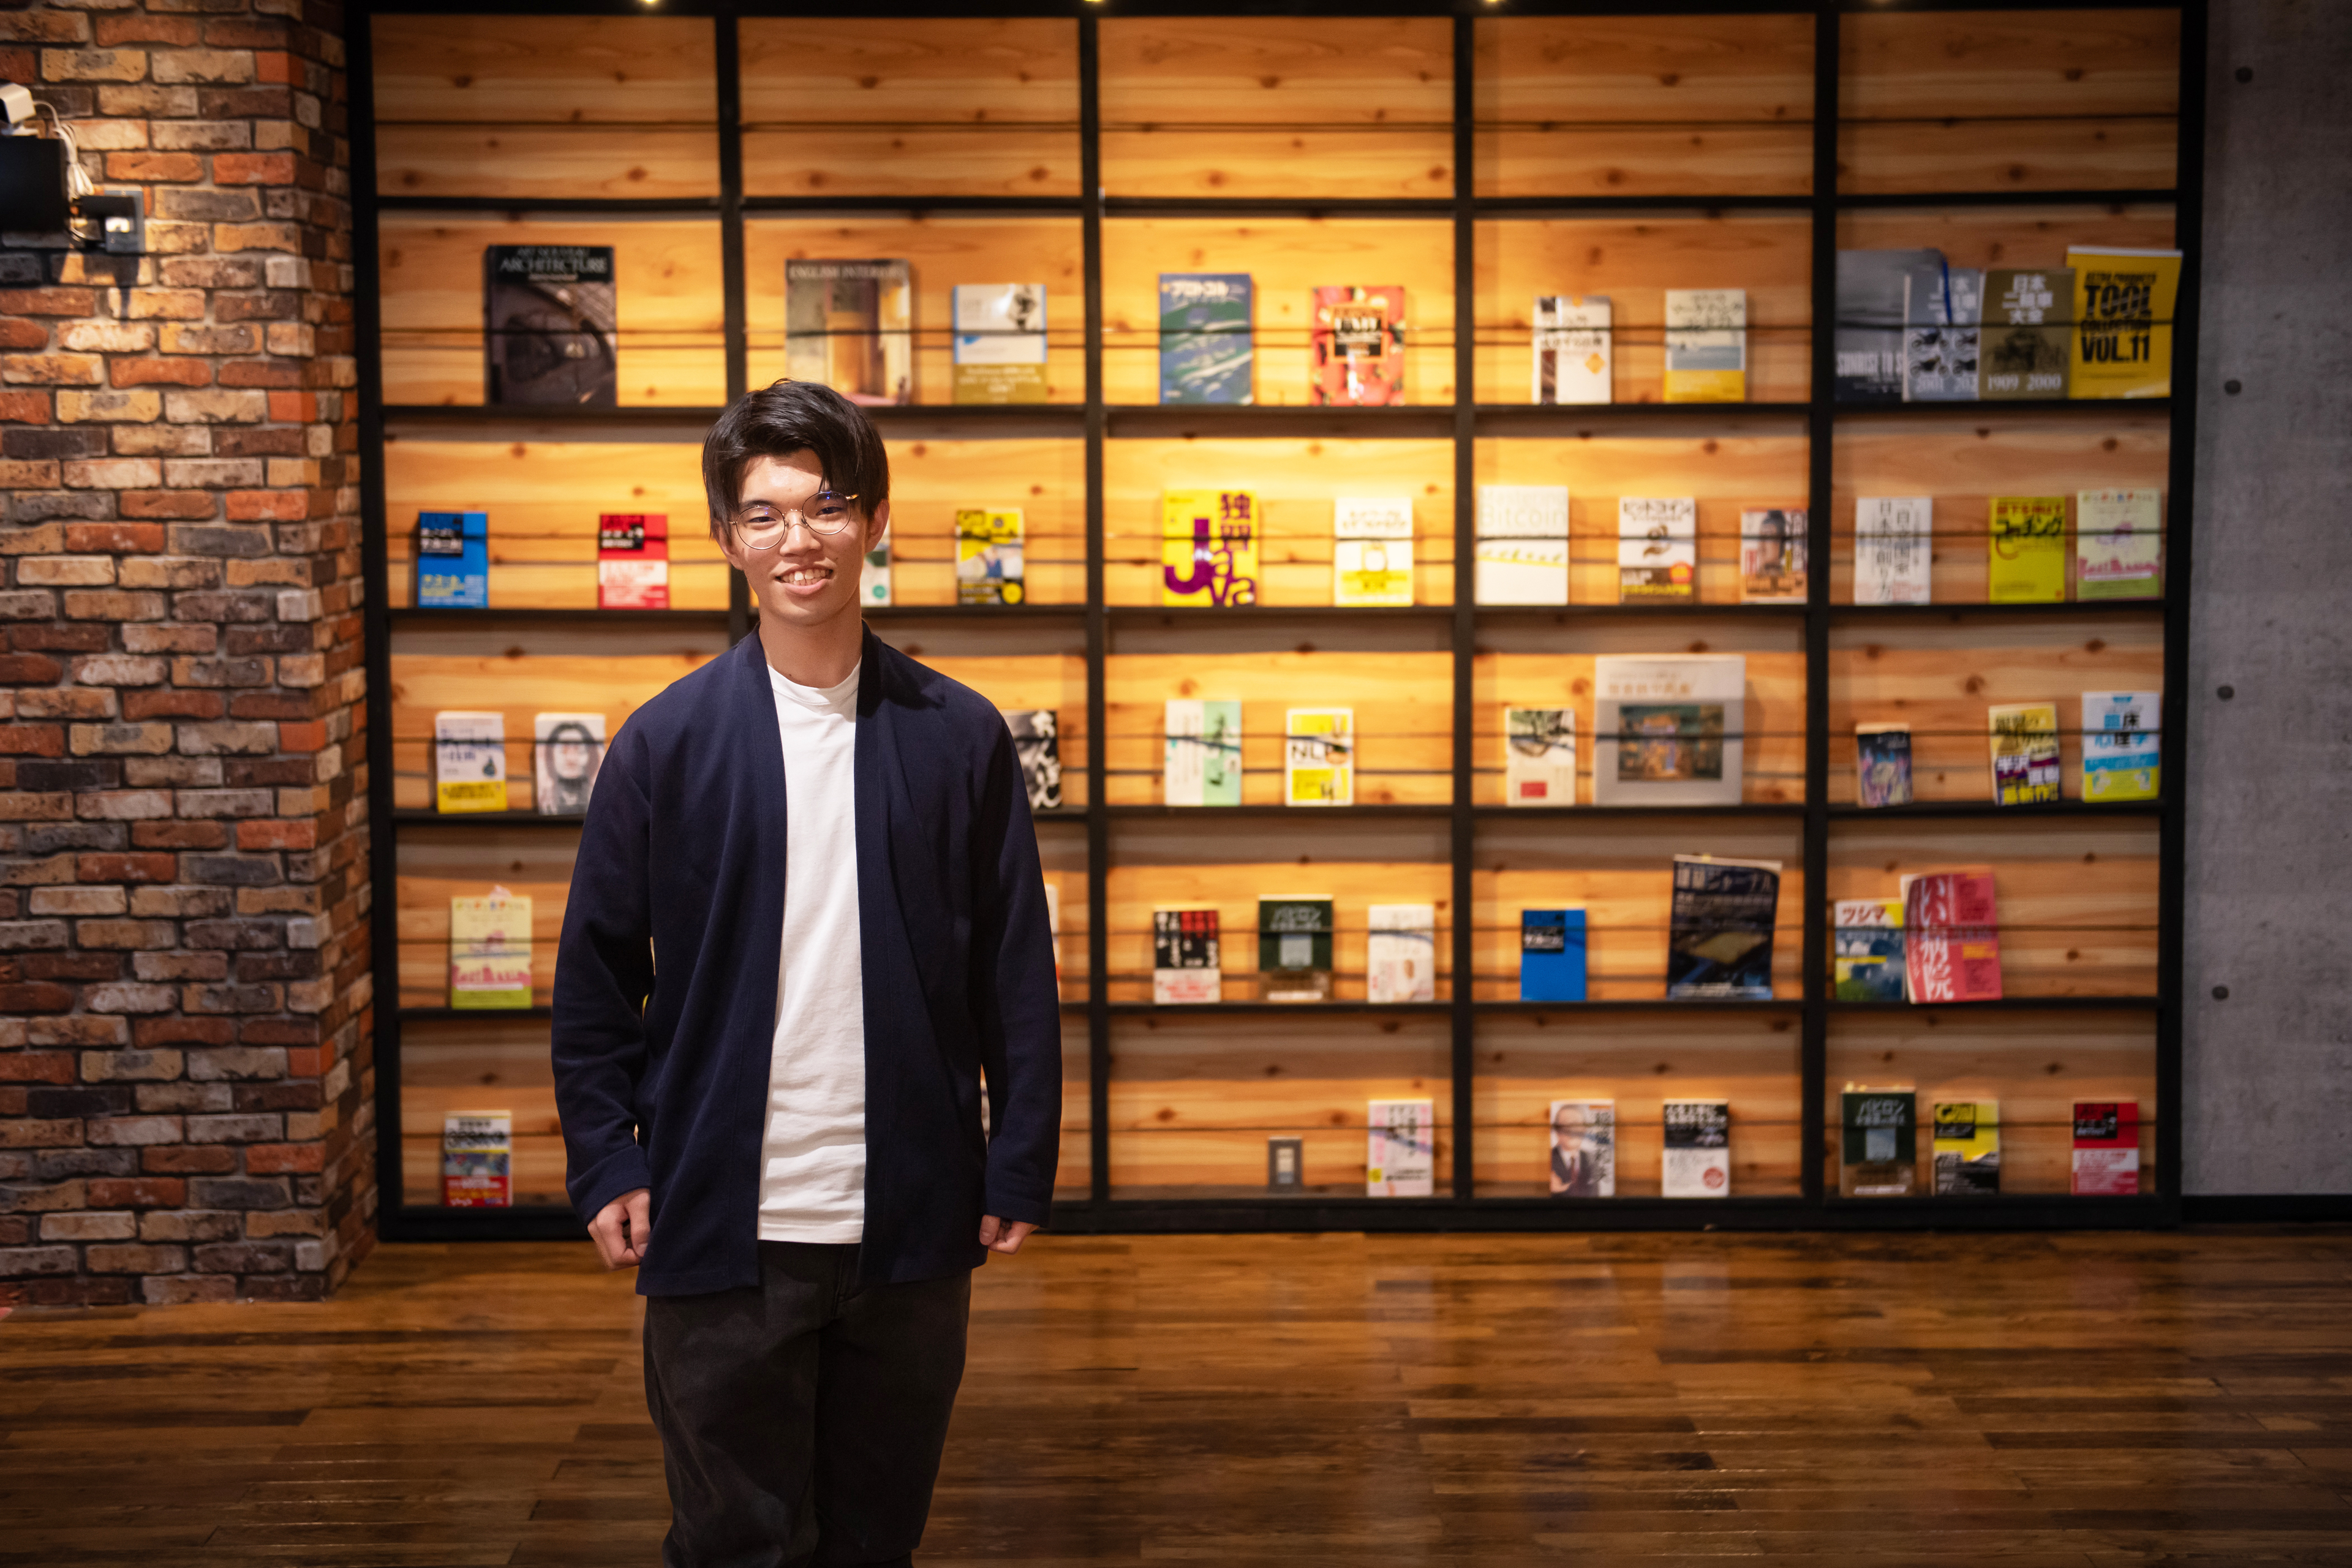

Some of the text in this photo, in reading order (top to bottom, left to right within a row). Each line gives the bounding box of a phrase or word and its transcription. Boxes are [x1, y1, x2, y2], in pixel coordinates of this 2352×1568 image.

[2013, 275, 2046, 292] 日本
[2084, 285, 2152, 319] TOOL
[1479, 503, 1566, 528] Bitcoin
